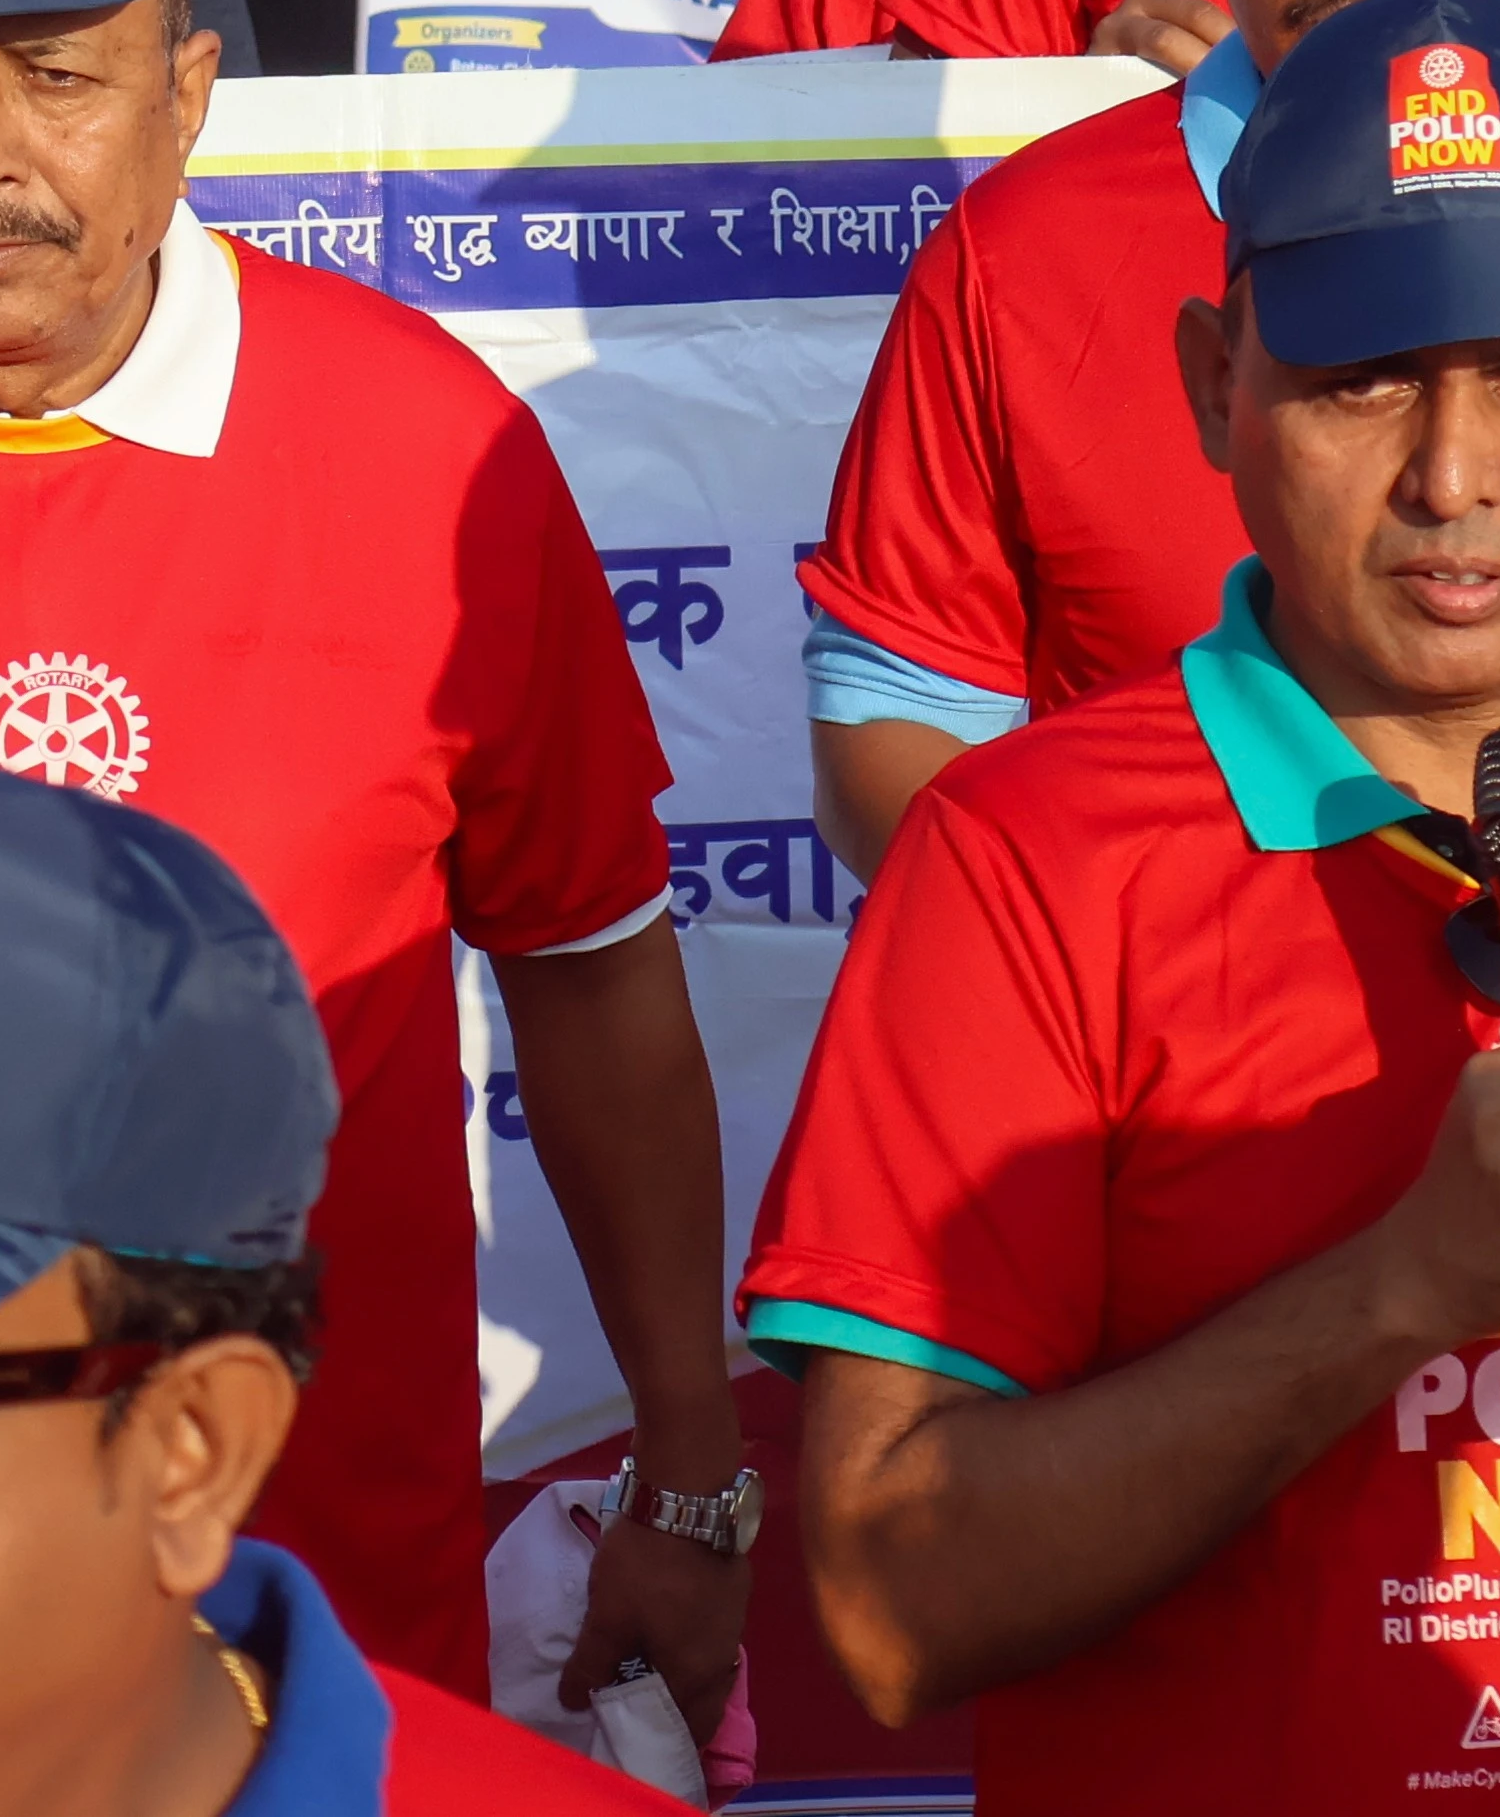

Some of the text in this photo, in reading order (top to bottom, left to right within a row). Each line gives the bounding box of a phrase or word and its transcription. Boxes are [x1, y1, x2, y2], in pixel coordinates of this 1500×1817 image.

[421, 22, 513, 43] Organizers
[1406, 89, 1486, 121] END
[1402, 139, 1495, 170] NOW
[408, 212, 500, 281] शुद्ध
[711, 208, 744, 257] र
[24, 670, 97, 690] ROTARY
[1383, 1616, 1413, 1644] RI
